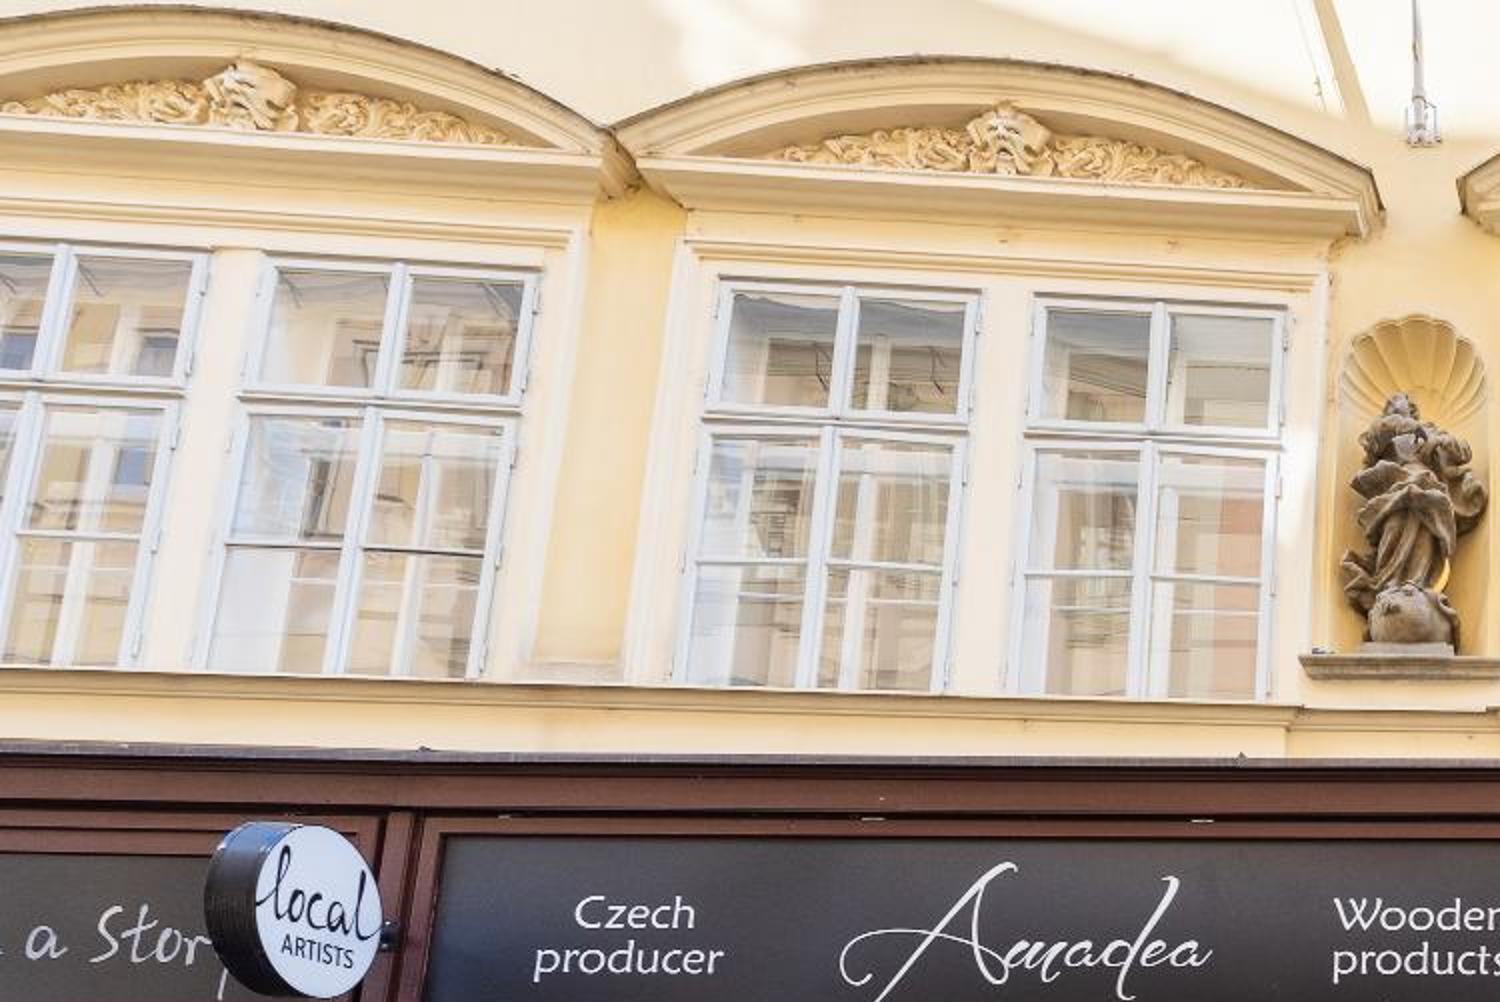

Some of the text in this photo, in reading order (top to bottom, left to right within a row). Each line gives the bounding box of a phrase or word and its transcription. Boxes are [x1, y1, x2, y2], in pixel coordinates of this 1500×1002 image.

[256, 844, 383, 941] local
[574, 895, 696, 929] Czech
[24, 903, 229, 1001] a Stor
[281, 934, 355, 969] ARTISTS
[533, 939, 725, 983] producer
